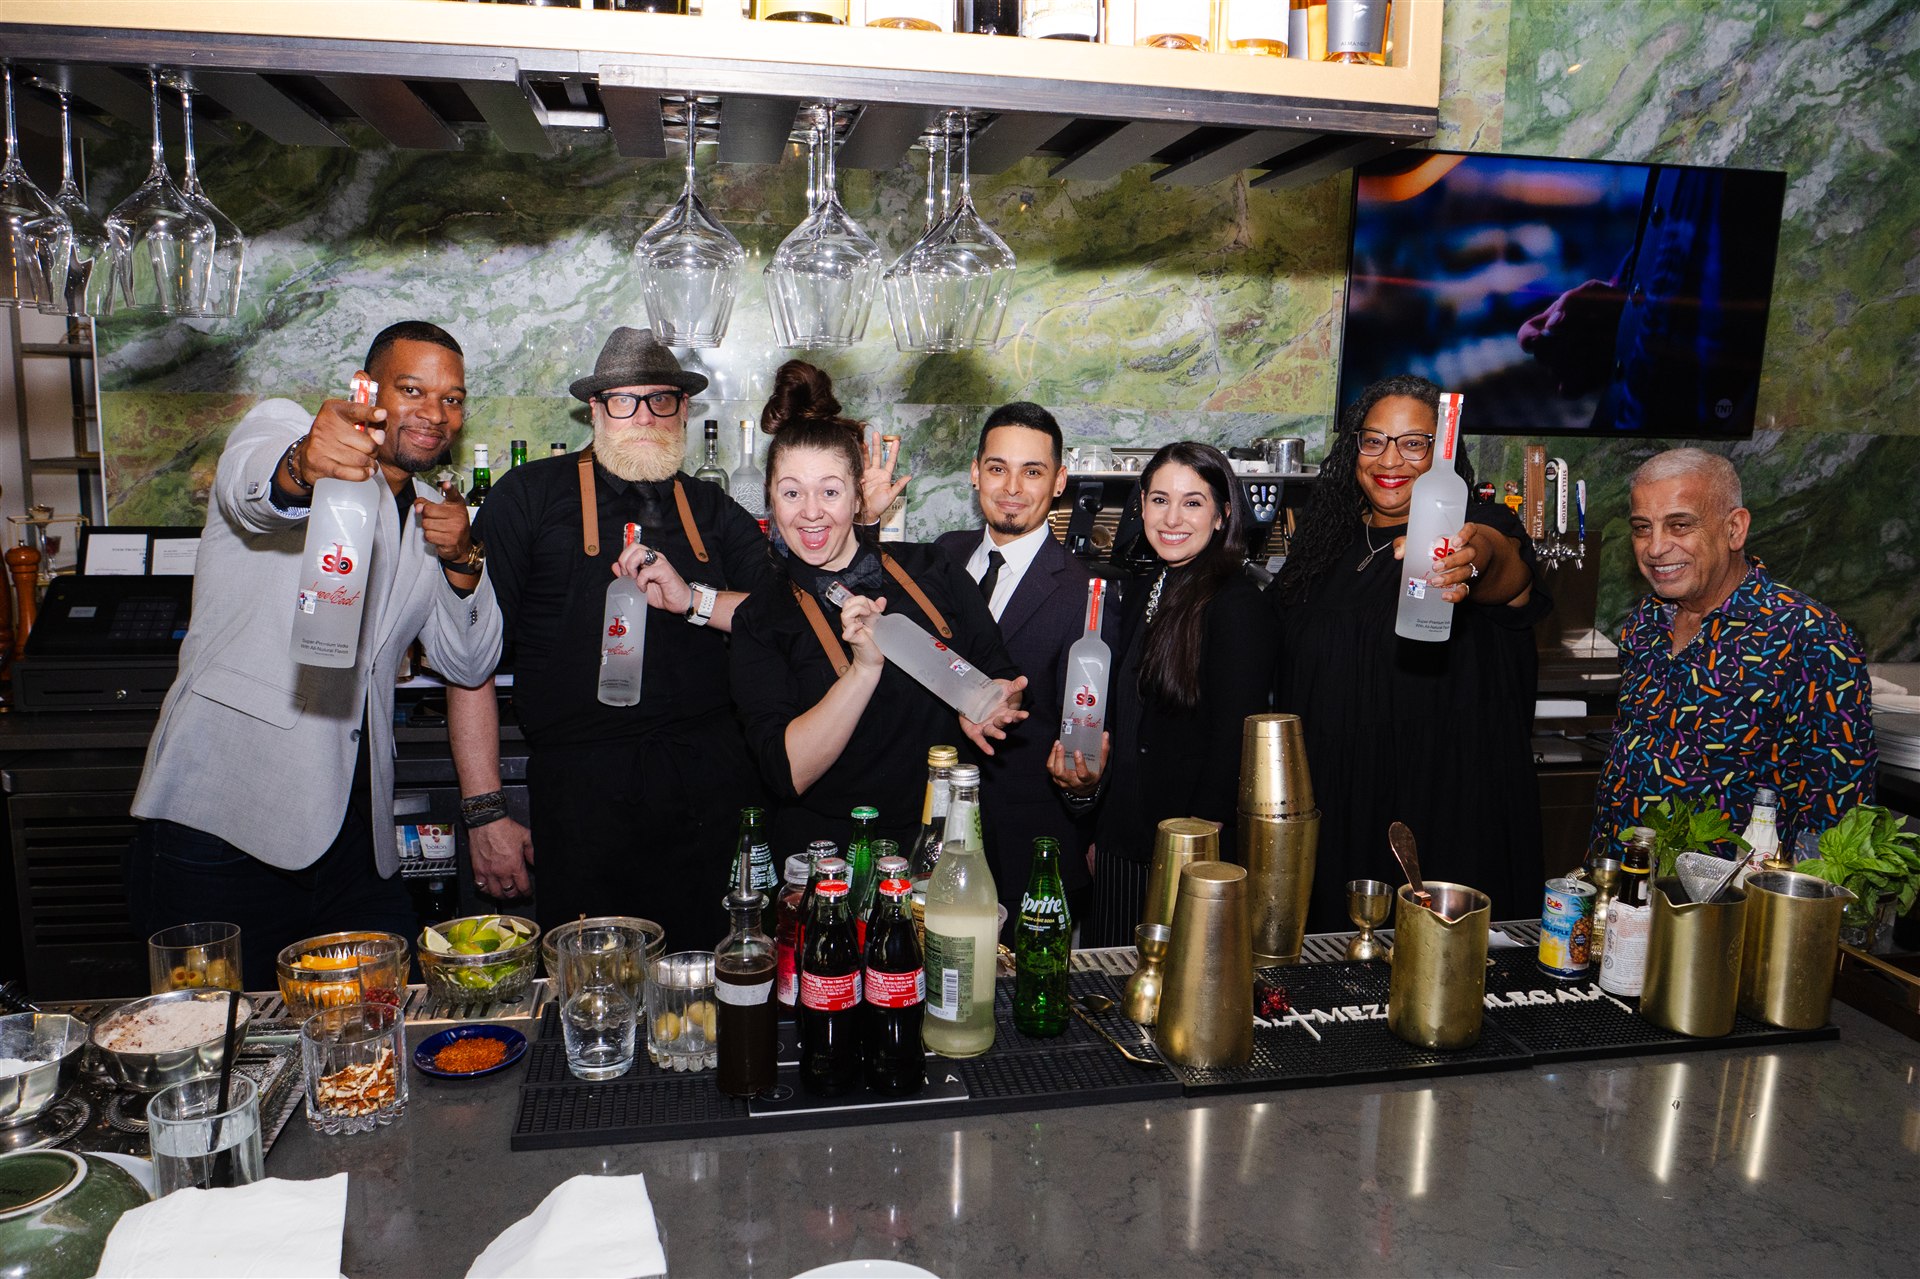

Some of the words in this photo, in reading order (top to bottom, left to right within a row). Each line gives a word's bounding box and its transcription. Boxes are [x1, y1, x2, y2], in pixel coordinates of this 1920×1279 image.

[1020, 891, 1063, 914] Sprite
[1546, 896, 1563, 909] Dole
[1311, 1003, 1389, 1023] MEZ
